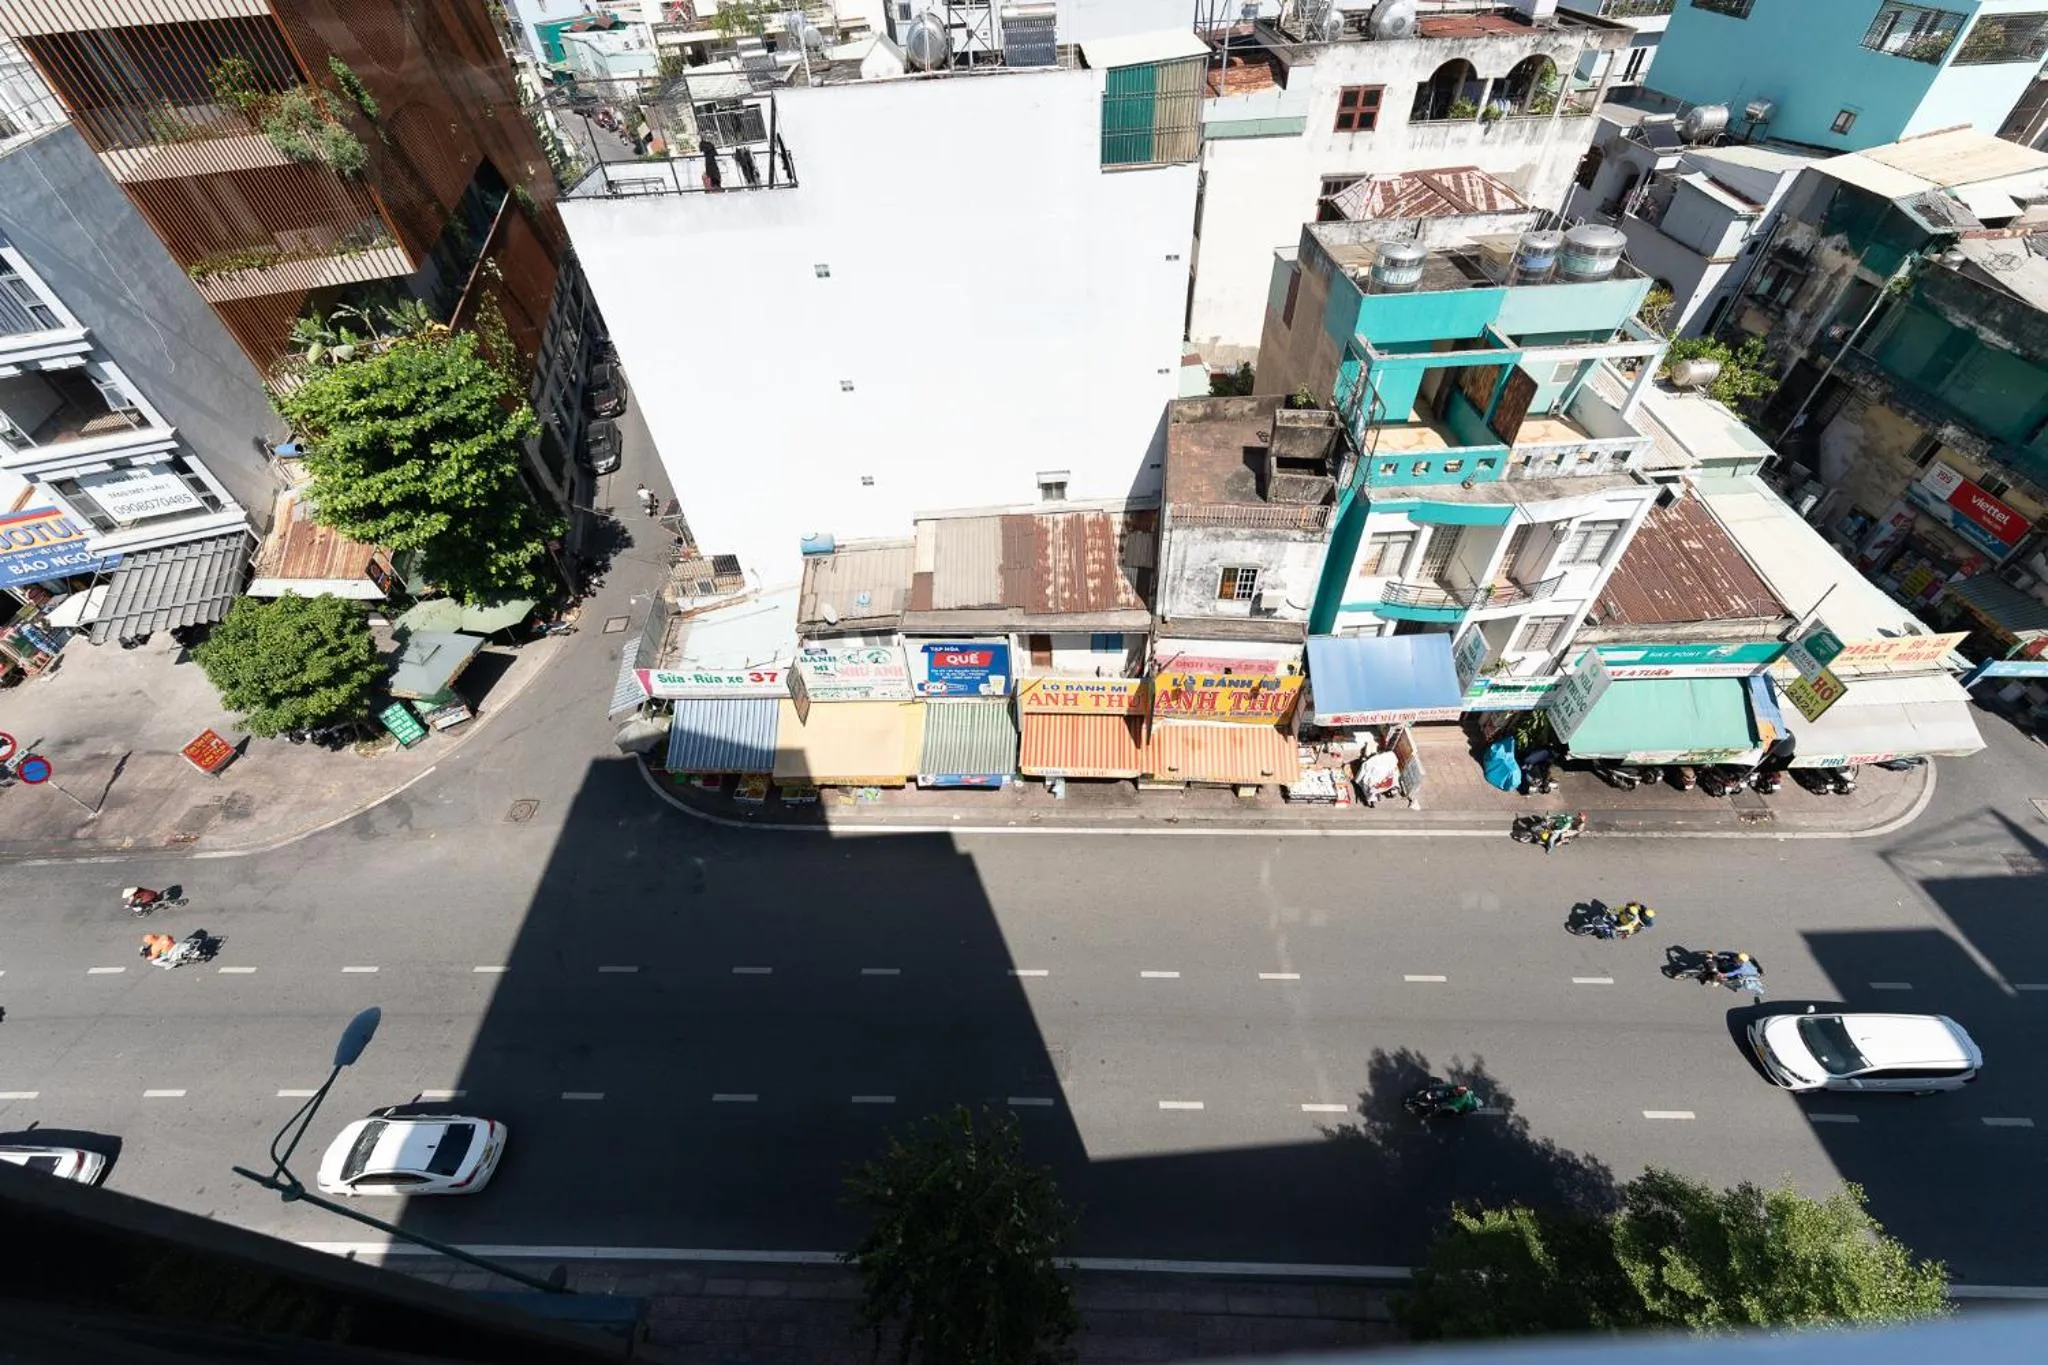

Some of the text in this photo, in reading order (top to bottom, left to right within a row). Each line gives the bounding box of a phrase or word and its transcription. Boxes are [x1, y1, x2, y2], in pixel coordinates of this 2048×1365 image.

[1972, 495, 2010, 525] viettel
[727, 675, 744, 684] xe
[749, 672, 778, 683] 37
[1027, 692, 1079, 706] ANH
[1155, 688, 1296, 711] ANH THƯ
